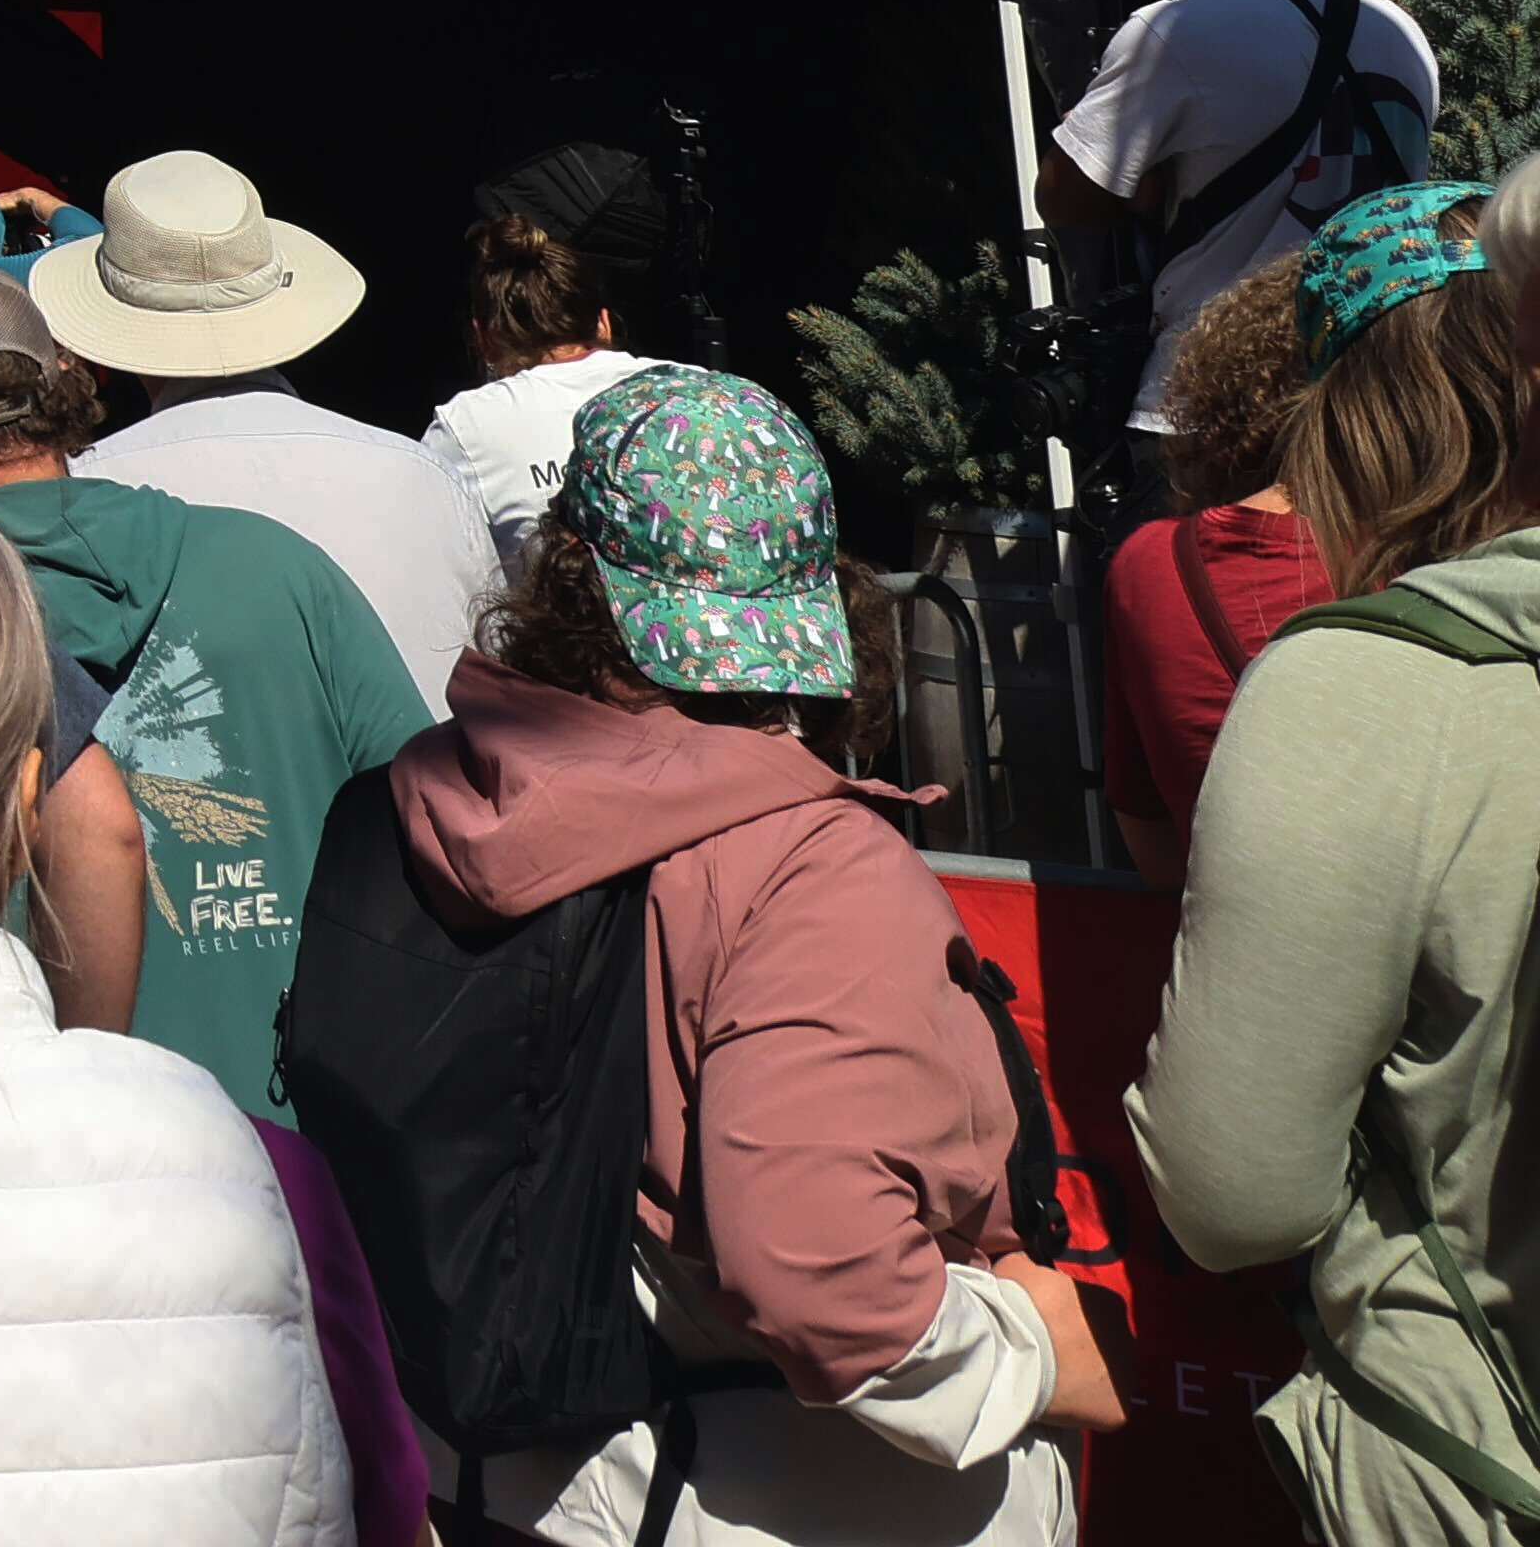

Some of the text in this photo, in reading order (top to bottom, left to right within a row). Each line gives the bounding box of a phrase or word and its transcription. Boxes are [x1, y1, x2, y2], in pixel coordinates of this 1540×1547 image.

[196, 859, 266, 890] LIVE
[191, 893, 293, 936] FREE.
[182, 935, 240, 956] REEL
